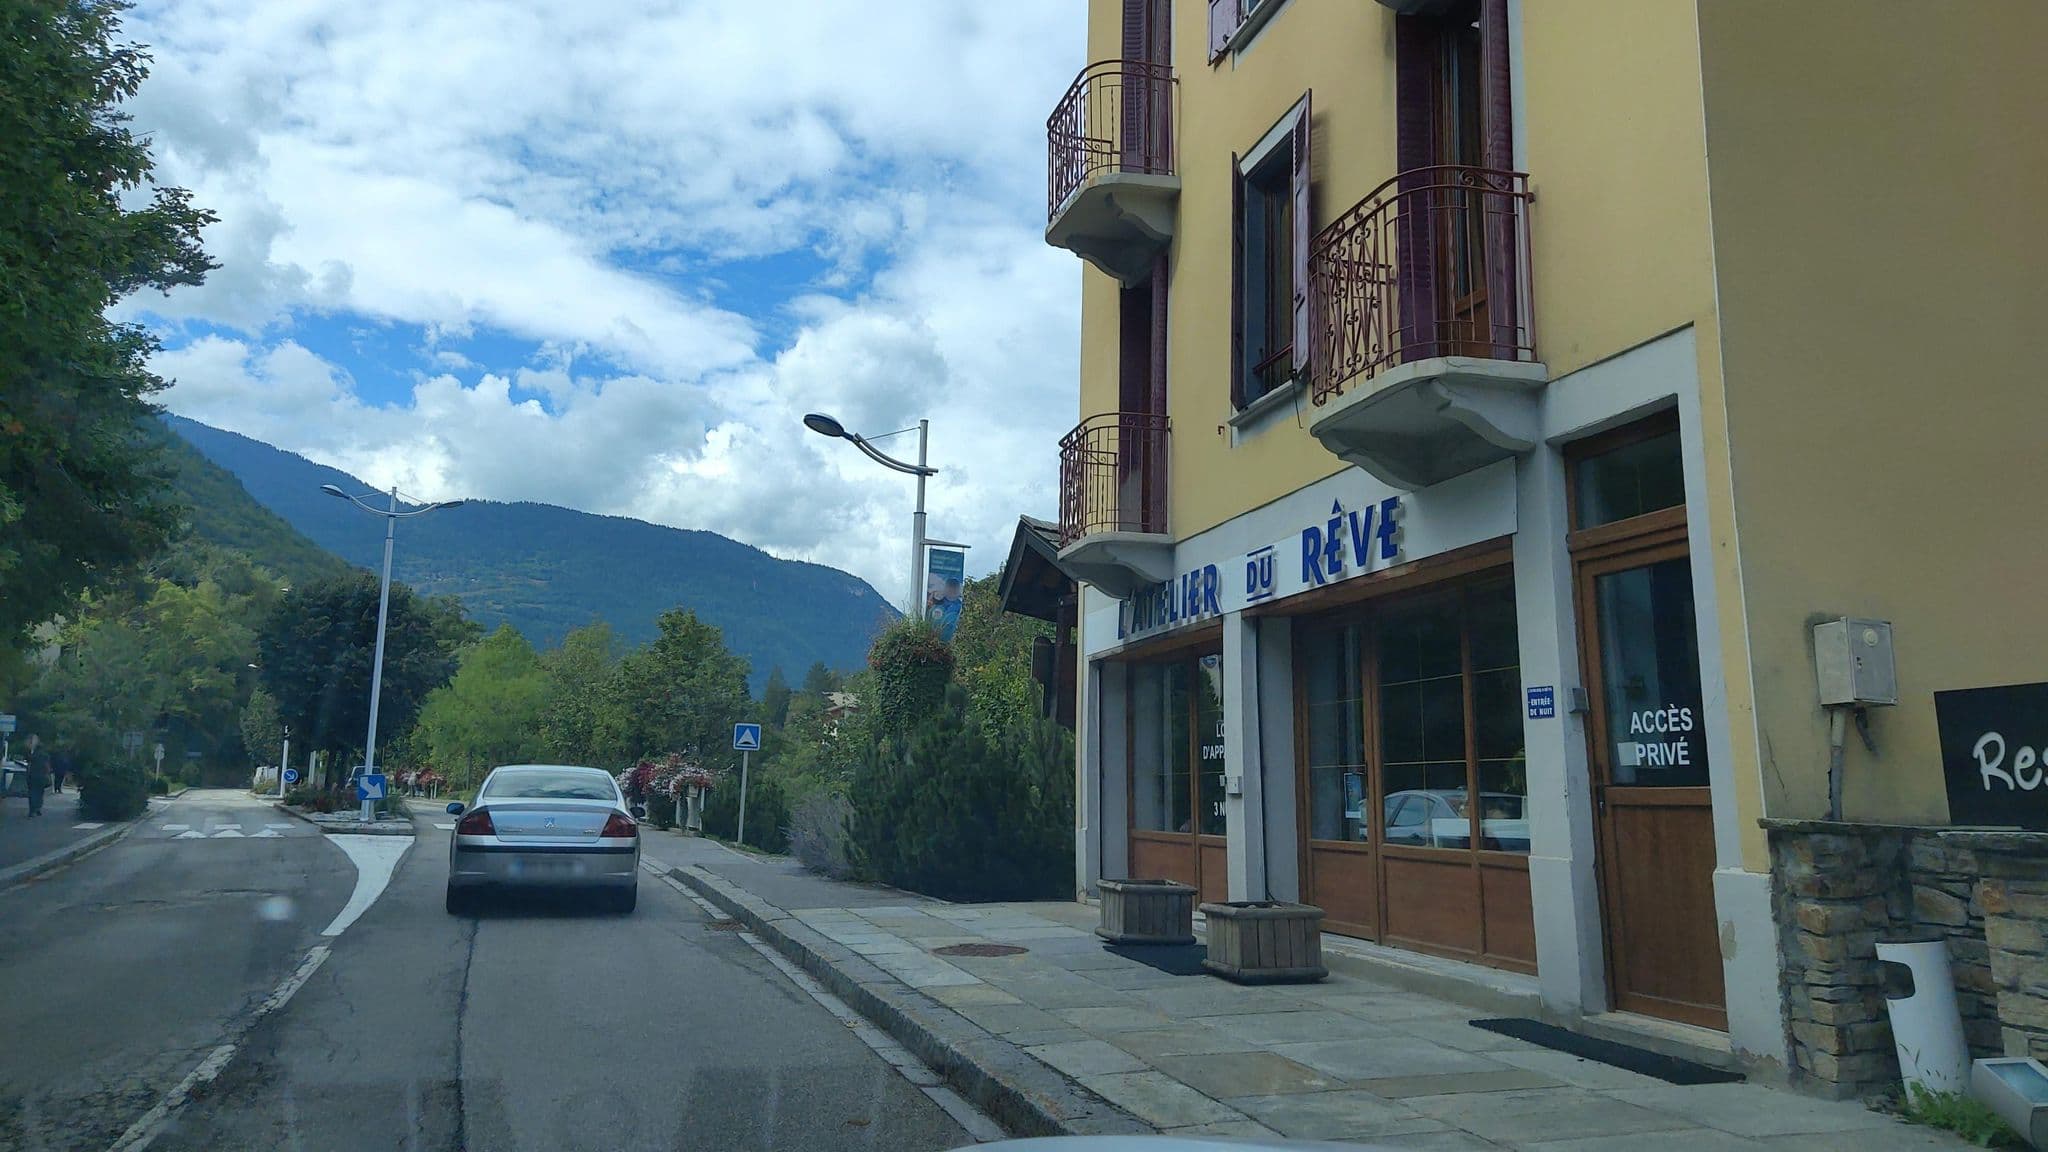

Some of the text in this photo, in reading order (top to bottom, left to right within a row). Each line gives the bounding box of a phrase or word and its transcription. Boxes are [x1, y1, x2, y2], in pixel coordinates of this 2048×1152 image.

[1246, 556, 1273, 595] DU
[1301, 497, 1400, 585] RÊVE
[1630, 703, 1693, 734] ACCÈS
[1203, 744, 1225, 759] D'APP
[1635, 736, 1690, 766] PRIVÉ
